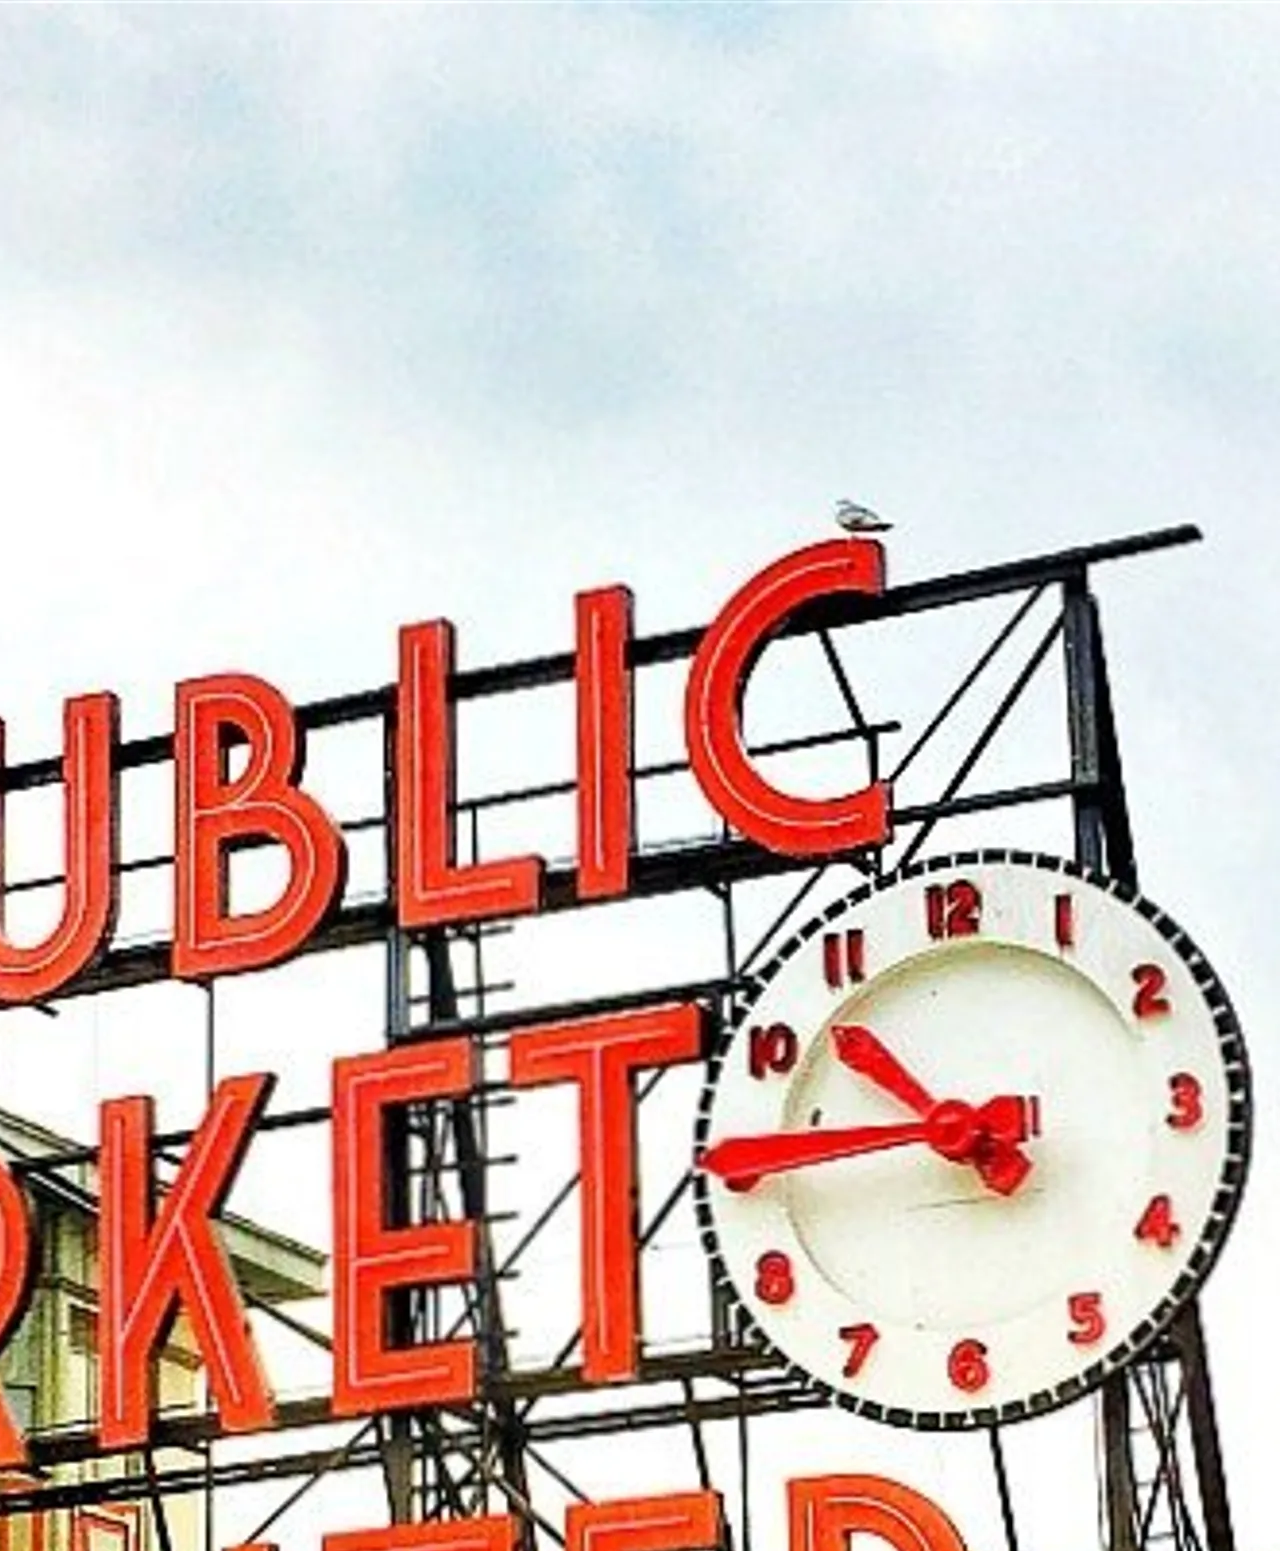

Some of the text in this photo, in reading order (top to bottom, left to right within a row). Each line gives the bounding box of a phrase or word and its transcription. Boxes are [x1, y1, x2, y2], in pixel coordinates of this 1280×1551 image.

[925, 879, 982, 939] 12
[1055, 894, 1073, 948] 1
[823, 930, 866, 989] 11
[1131, 964, 1169, 1018] 2
[749, 1023, 798, 1079] 10
[1167, 1073, 1203, 1129] 3
[1133, 1195, 1180, 1248] 4
[756, 1250, 796, 1305] 8
[1067, 1293, 1106, 1346] 5
[839, 1323, 880, 1378] 7
[947, 1339, 990, 1393] 6
